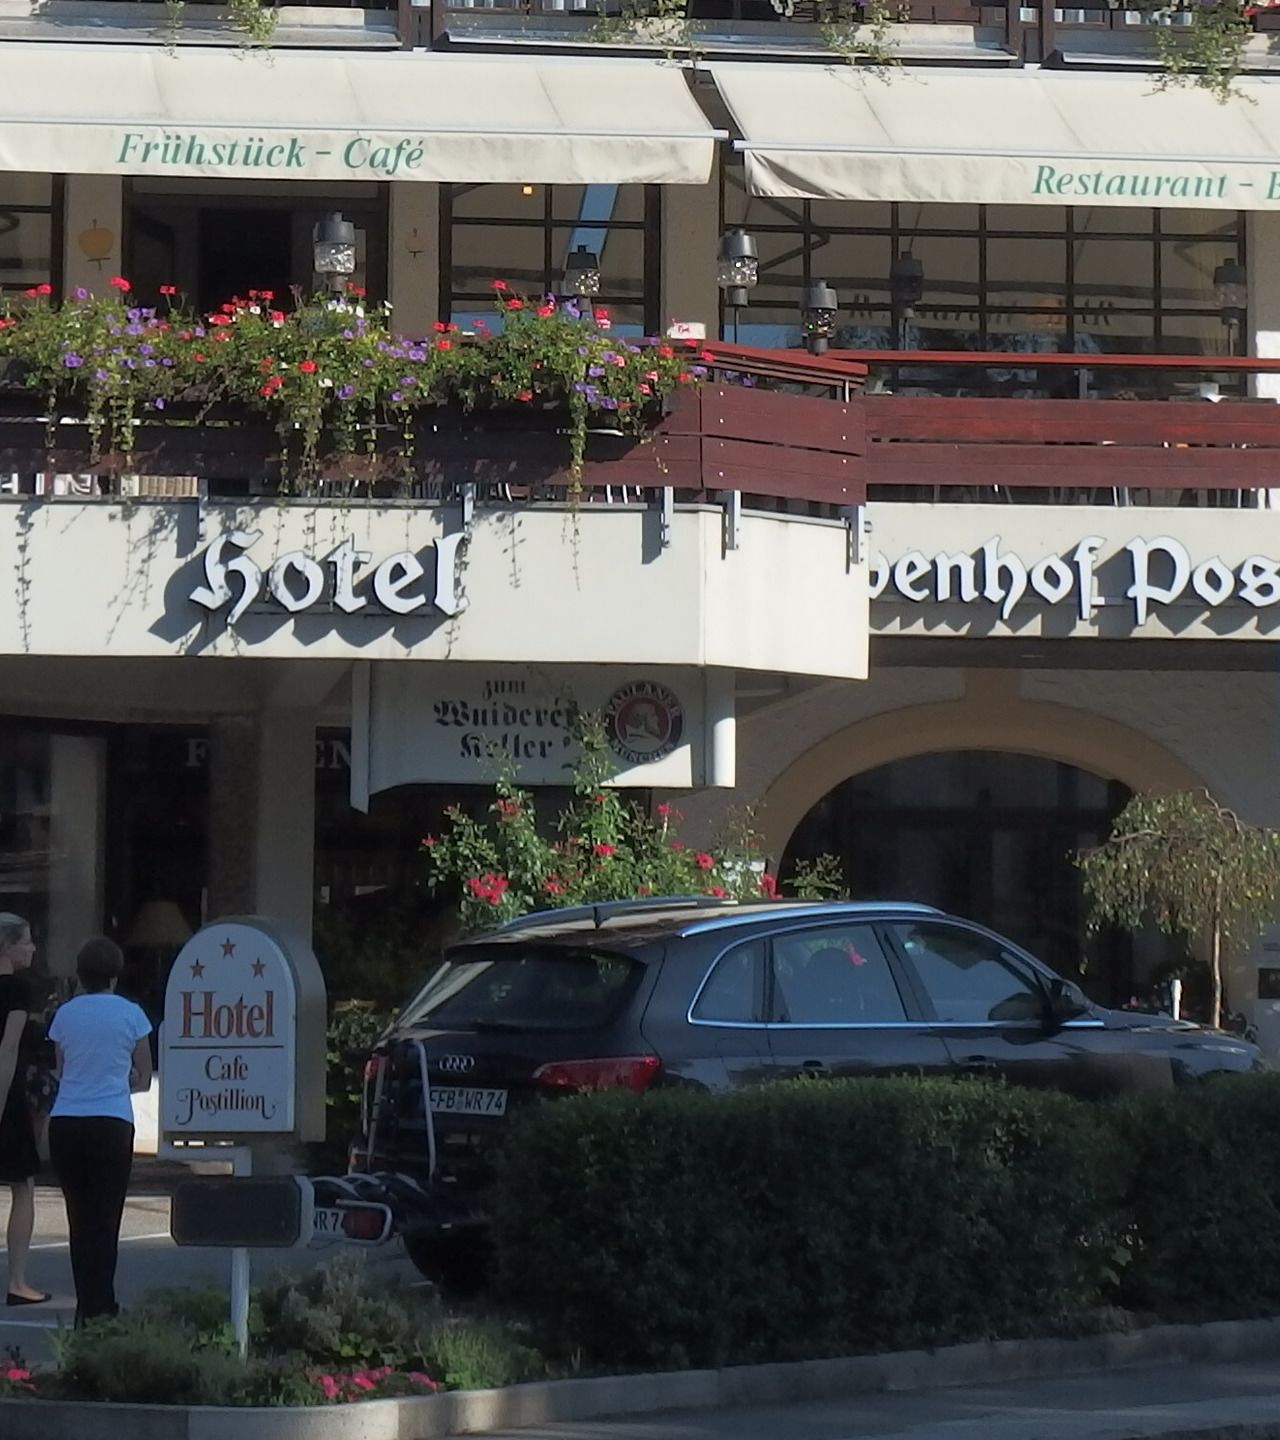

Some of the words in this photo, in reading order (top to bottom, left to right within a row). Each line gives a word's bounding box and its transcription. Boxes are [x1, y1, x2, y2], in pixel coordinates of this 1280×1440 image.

[116, 133, 307, 169] Frühstück
[343, 137, 425, 176] Café
[1031, 164, 1228, 199] Restaurant
[189, 529, 471, 625] Hotel
[482, 679, 527, 701] zum
[177, 989, 276, 1040] Hotel
[204, 1055, 249, 1081] Cafe
[175, 1088, 277, 1126] Postillion
[485, 1091, 504, 1112] 74
